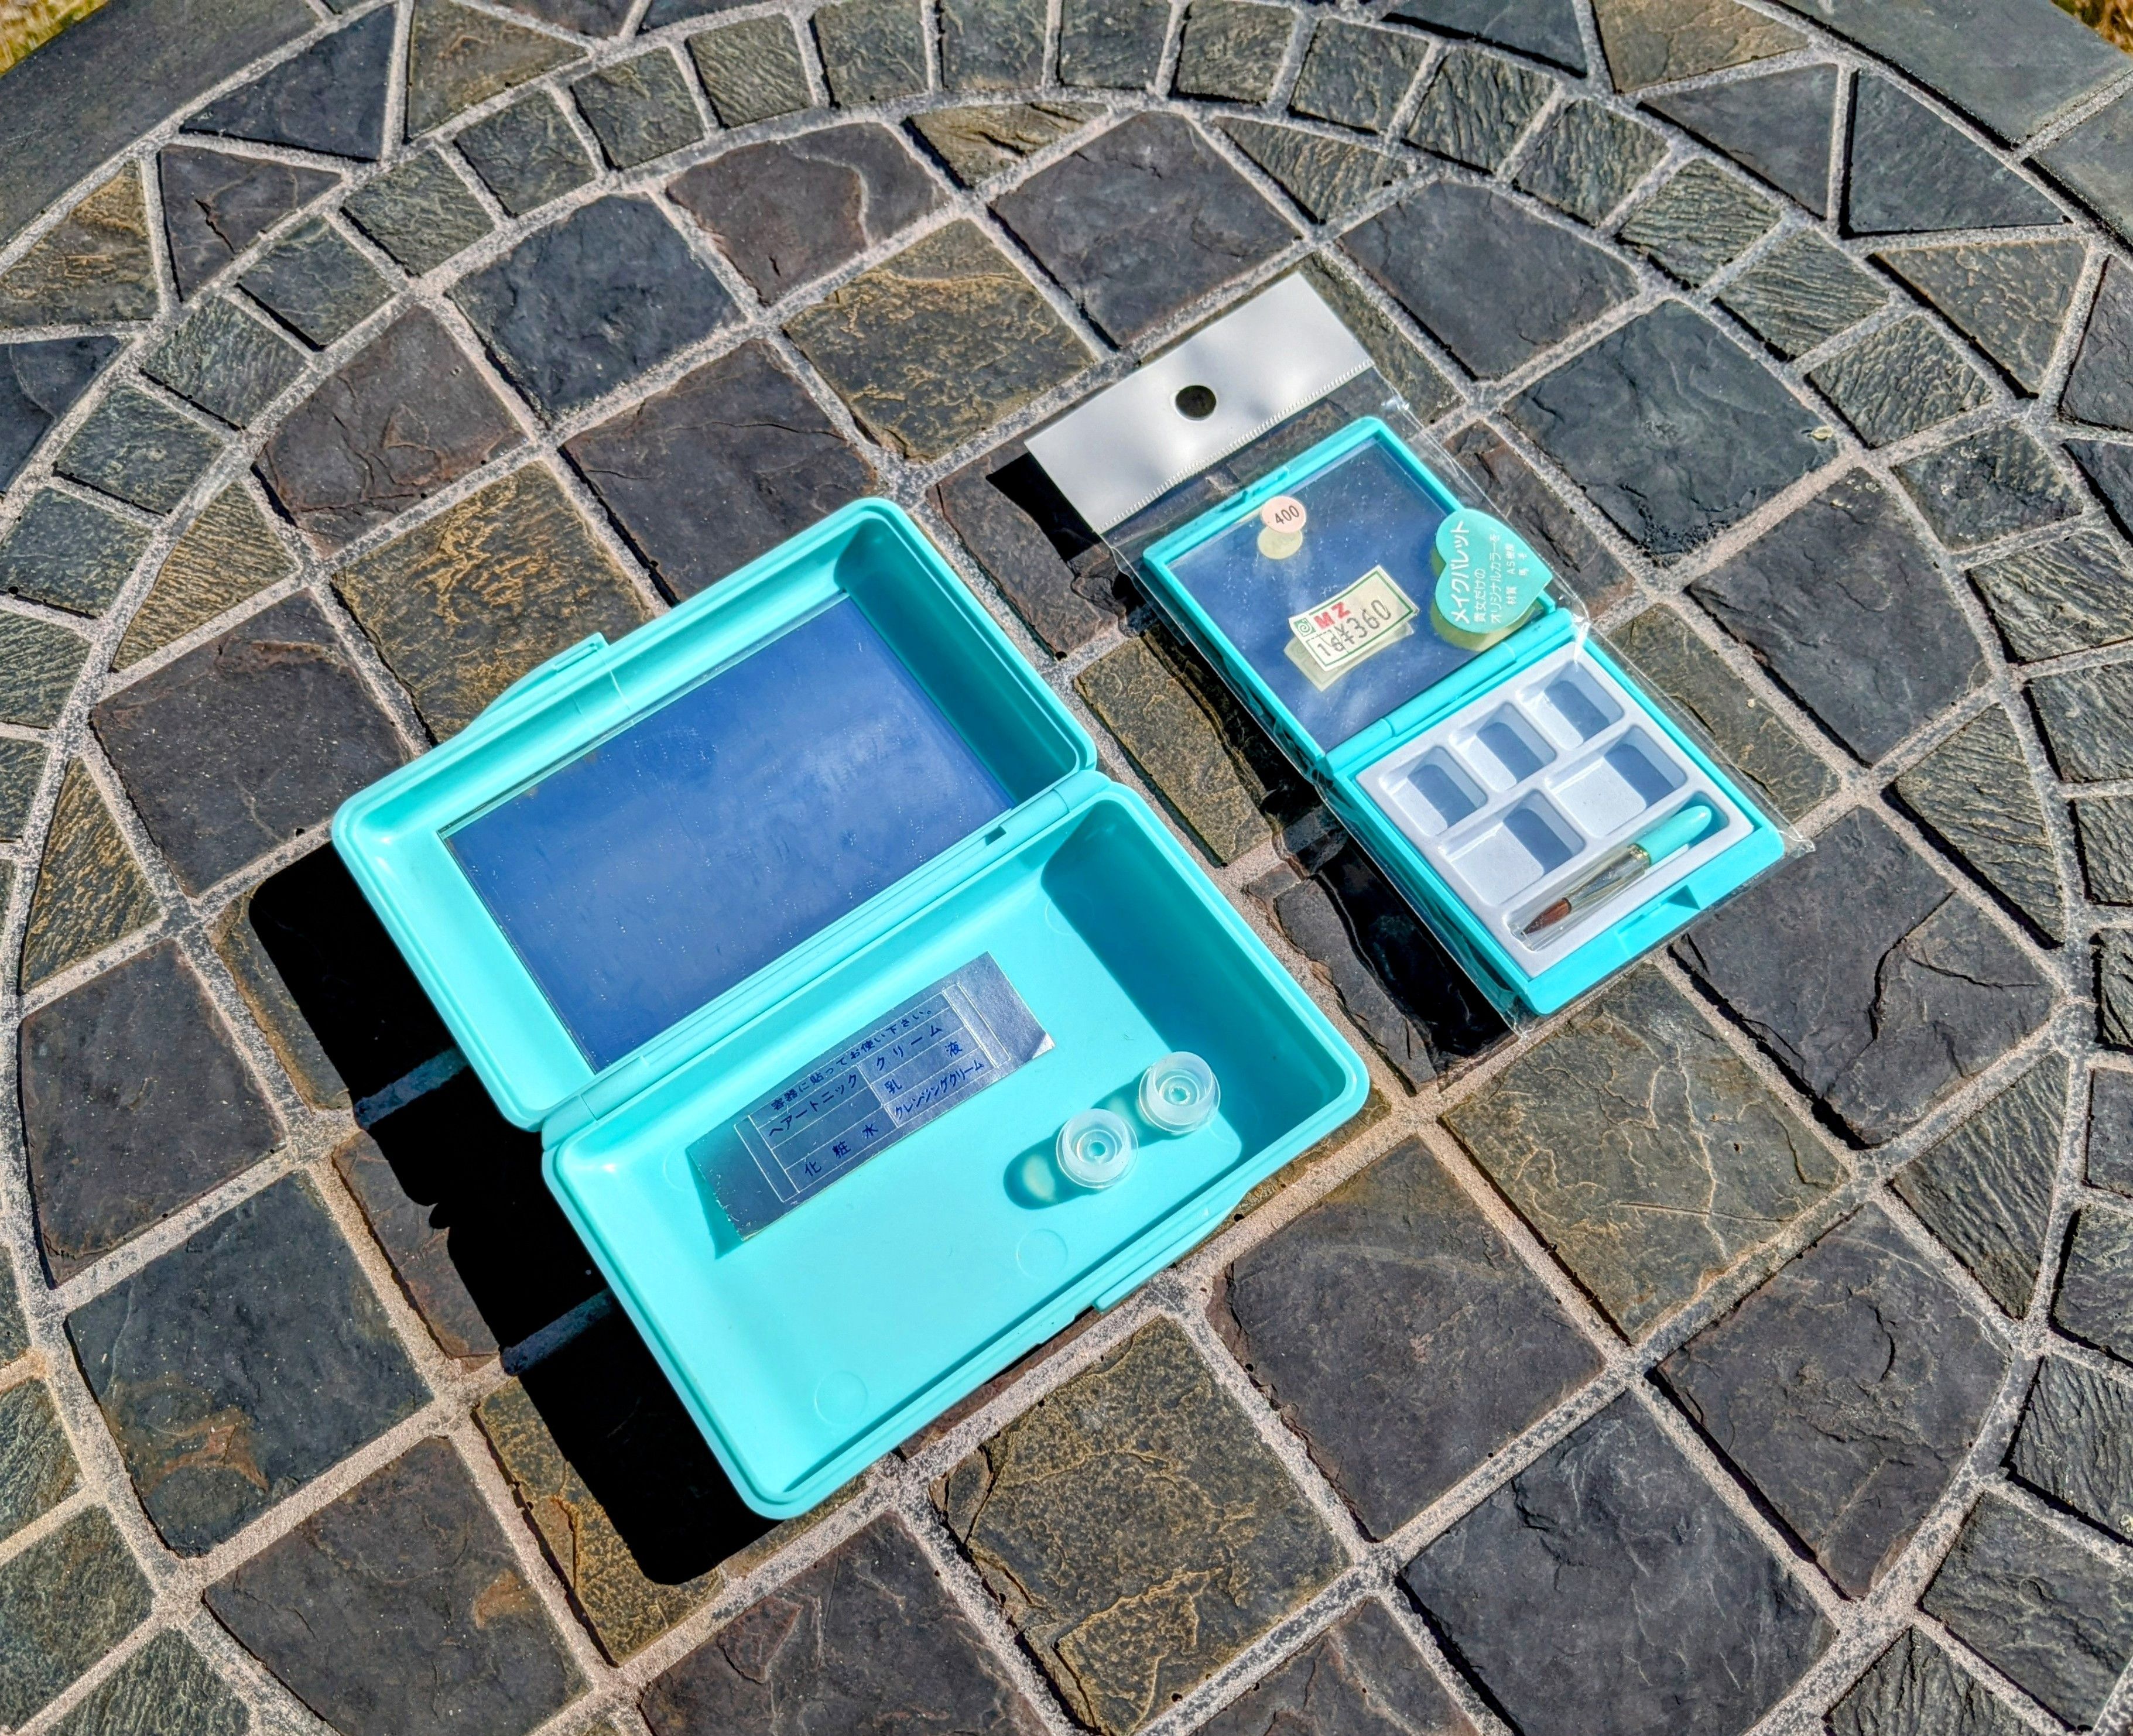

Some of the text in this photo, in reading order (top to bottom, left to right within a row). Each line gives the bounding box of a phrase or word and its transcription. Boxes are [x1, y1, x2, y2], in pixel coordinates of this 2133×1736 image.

[1275, 505, 1299, 525] 400
[771, 1010, 931, 1110] 容器に貼ってお使い下さい。
[877, 1025, 942, 1071] クリーム
[769, 1074, 857, 1136] ヘアートニック
[895, 1060, 984, 1119] クレンジングクリーム
